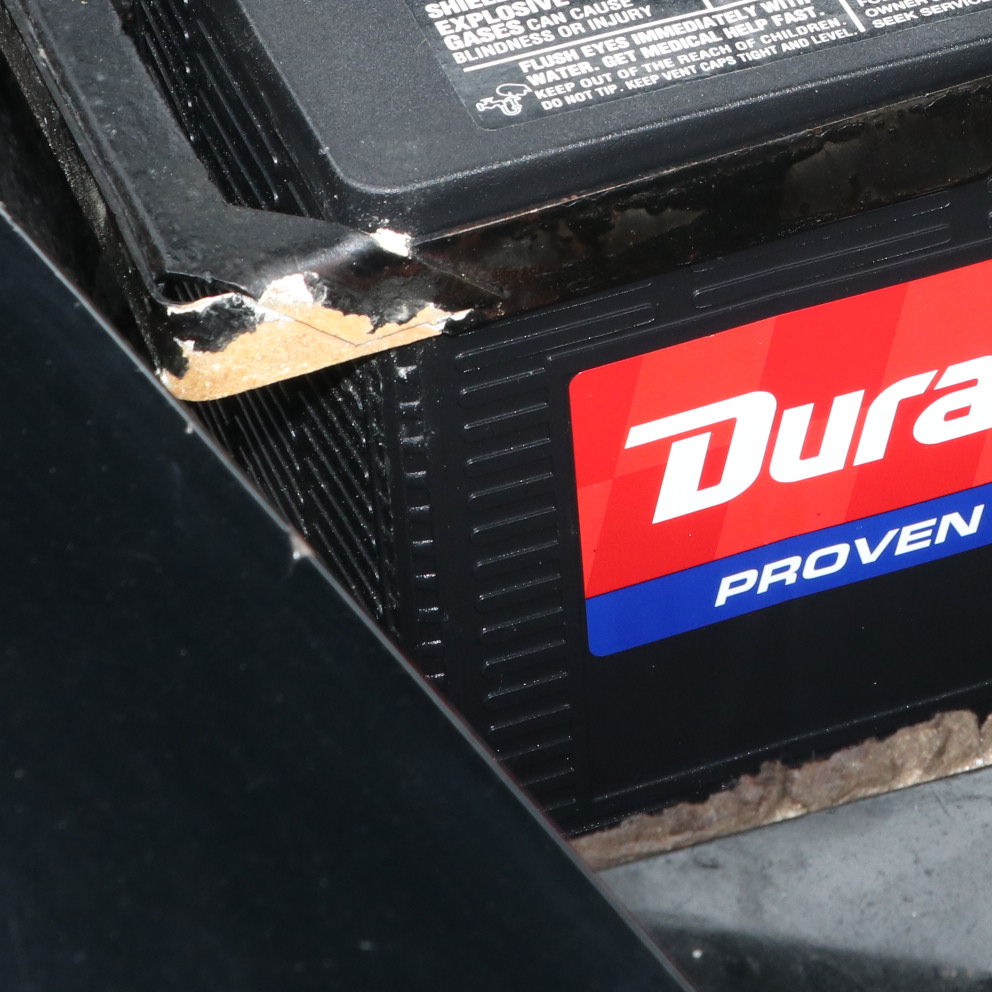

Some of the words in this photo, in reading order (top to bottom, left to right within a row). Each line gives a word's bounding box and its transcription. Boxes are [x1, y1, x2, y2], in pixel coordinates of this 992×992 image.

[443, 18, 526, 51] GASES
[526, 11, 568, 31] CAN
[452, 30, 556, 64] BLINDNESS
[558, 22, 586, 38] OR
[587, 4, 652, 32] INJURY
[518, 48, 580, 74] FLUSH
[580, 36, 630, 58] EYES
[631, 5, 757, 46] IMMEDIATELY
[526, 61, 600, 86] WATER.
[602, 50, 638, 68] GET
[640, 28, 723, 59] MEDICAL
[722, 18, 768, 40] HELP
[771, 6, 826, 27] FAST.
[872, 10, 918, 29] SEEK
[534, 82, 576, 100] KEEP
[580, 72, 612, 88] OUT
[617, 66, 639, 80] OF
[640, 58, 676, 73] THE
[676, 44, 732, 64] REACH
[734, 38, 757, 52] OF
[760, 17, 847, 44] CHILDREN.
[540, 98, 564, 111] DO
[565, 89, 594, 105] NOT
[624, 74, 660, 90] KEEP
[662, 64, 697, 82] VENT
[700, 56, 738, 72] CAPS
[737, 46, 778, 62] TIGHT
[781, 38, 810, 52] AND
[812, 28, 858, 44] LEVEL.
[713, 505, 986, 608] PROVEN
